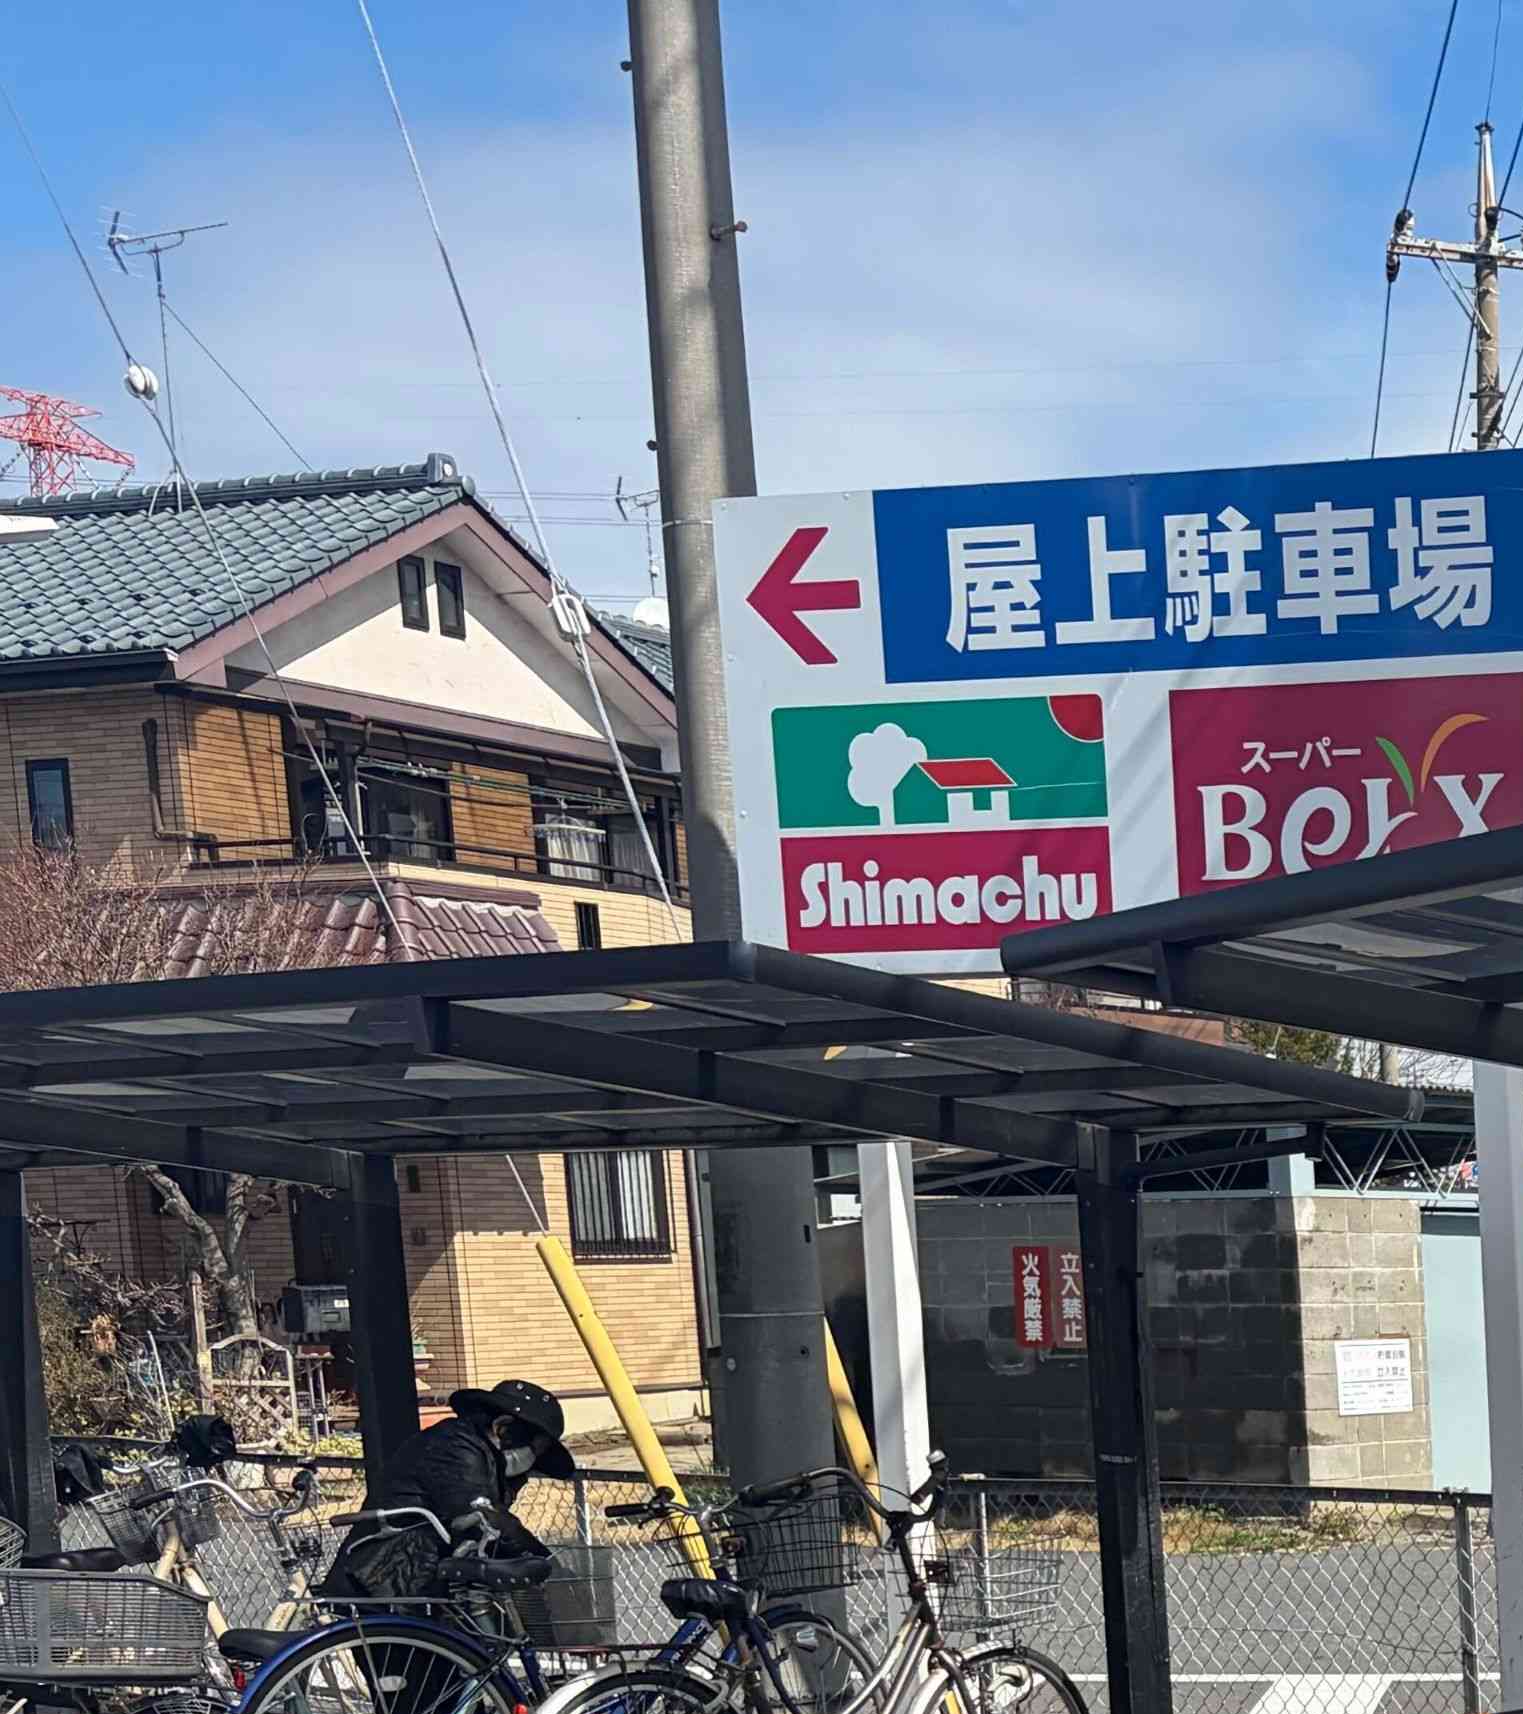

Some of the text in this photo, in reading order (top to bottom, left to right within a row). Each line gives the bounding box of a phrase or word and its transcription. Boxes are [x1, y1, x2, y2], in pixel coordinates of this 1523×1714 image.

[944, 494, 1495, 653] 屋上駐車場
[1240, 736, 1361, 774] スーパー
[799, 855, 1098, 928] Shimachu
[1060, 1252, 1083, 1342] 立入禁止
